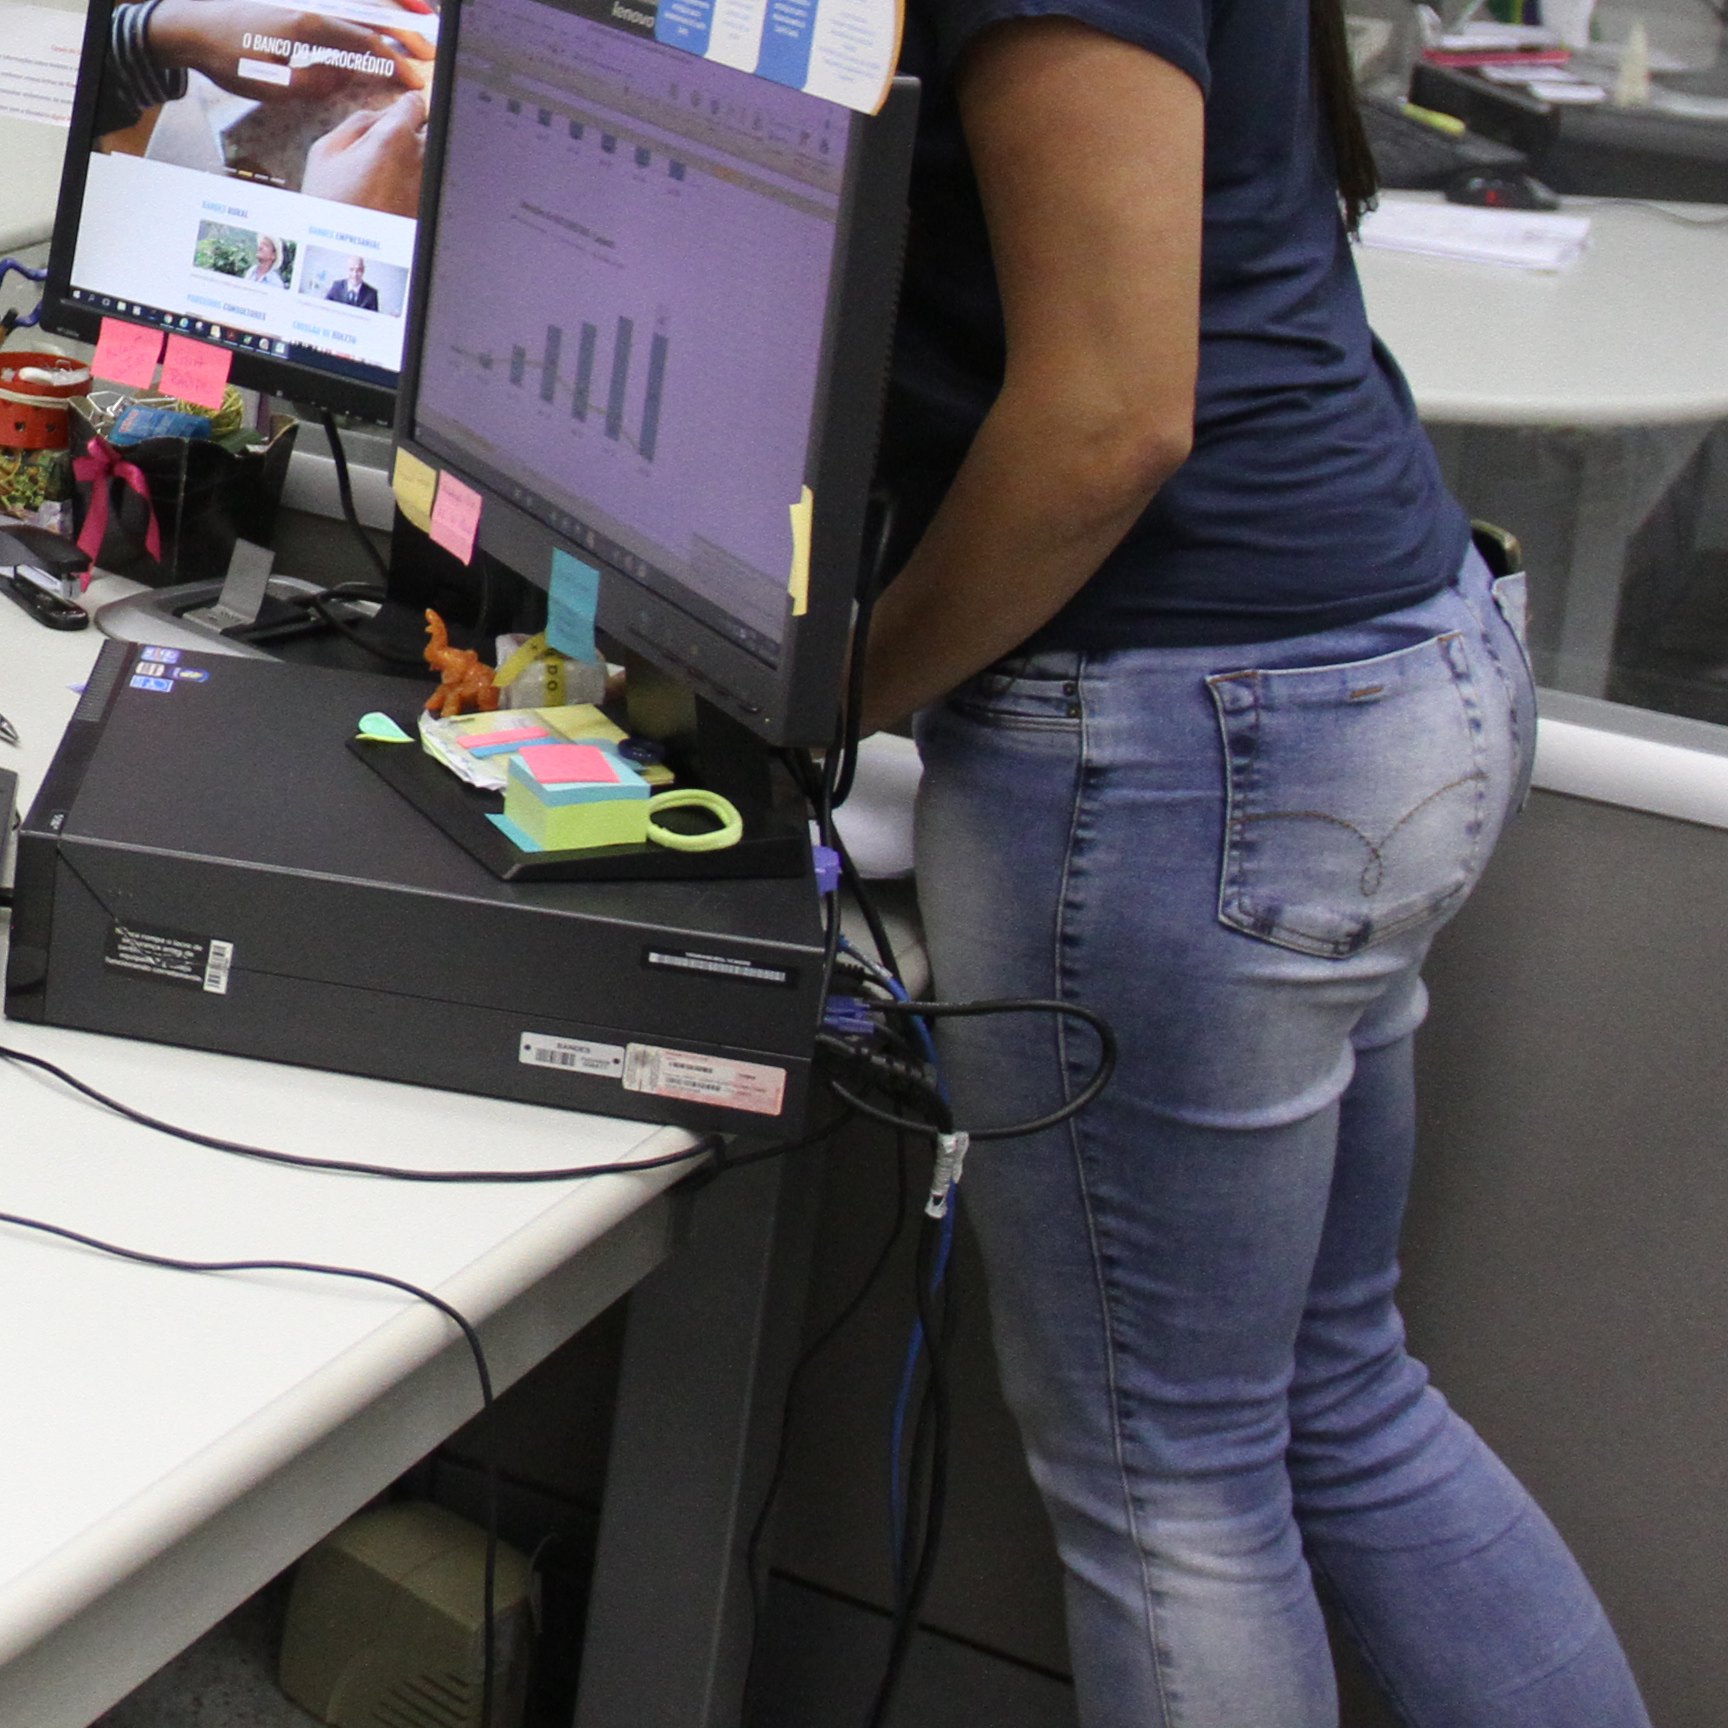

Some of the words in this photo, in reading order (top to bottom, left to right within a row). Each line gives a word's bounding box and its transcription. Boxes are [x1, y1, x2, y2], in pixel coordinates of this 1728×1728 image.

[612, 1, 655, 28] lenovo
[243, 32, 252, 48] O
[253, 34, 291, 57] BANCO
[293, 42, 309, 58] DO
[311, 46, 394, 77] MICROCRÉDITO
